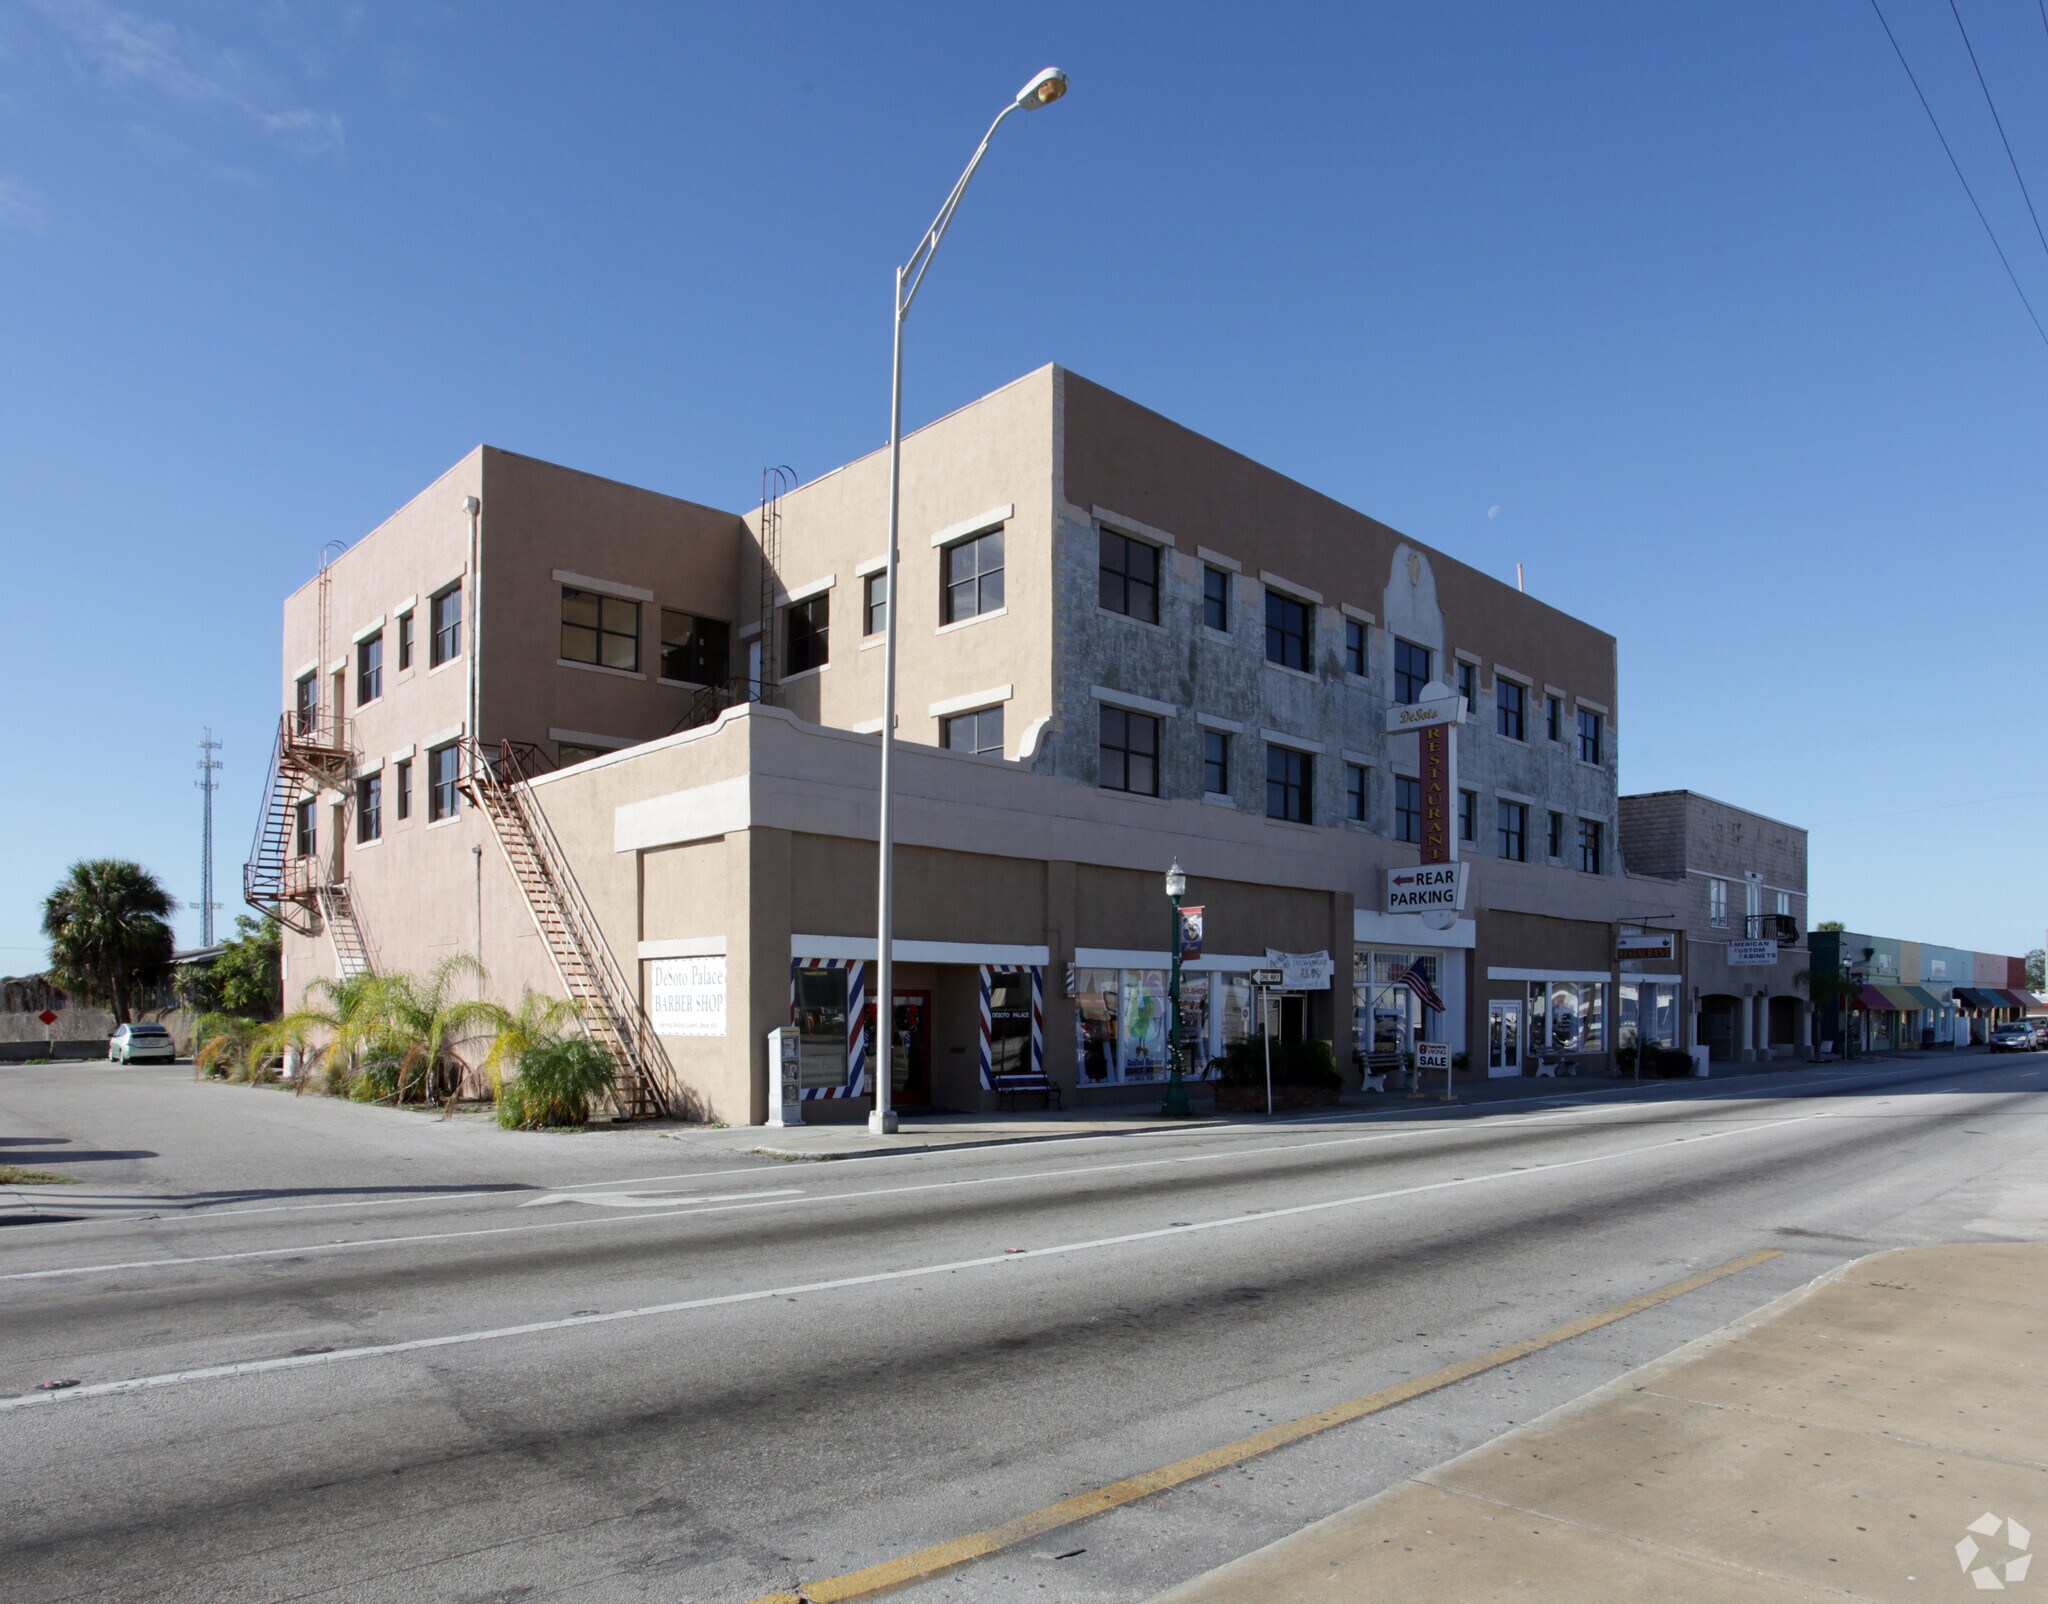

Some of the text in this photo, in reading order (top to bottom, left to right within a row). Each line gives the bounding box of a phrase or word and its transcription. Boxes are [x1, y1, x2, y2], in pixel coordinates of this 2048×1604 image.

[1400, 708, 1439, 724] DeSoto
[1426, 728, 1443, 860] RESTAURANT
[1416, 870, 1454, 886] REAR
[1390, 889, 1453, 906] PARKING
[655, 965, 723, 986] DeSoto Palace
[655, 994, 723, 1012] BARBER SHOP
[1420, 1056, 1446, 1066] SALE
